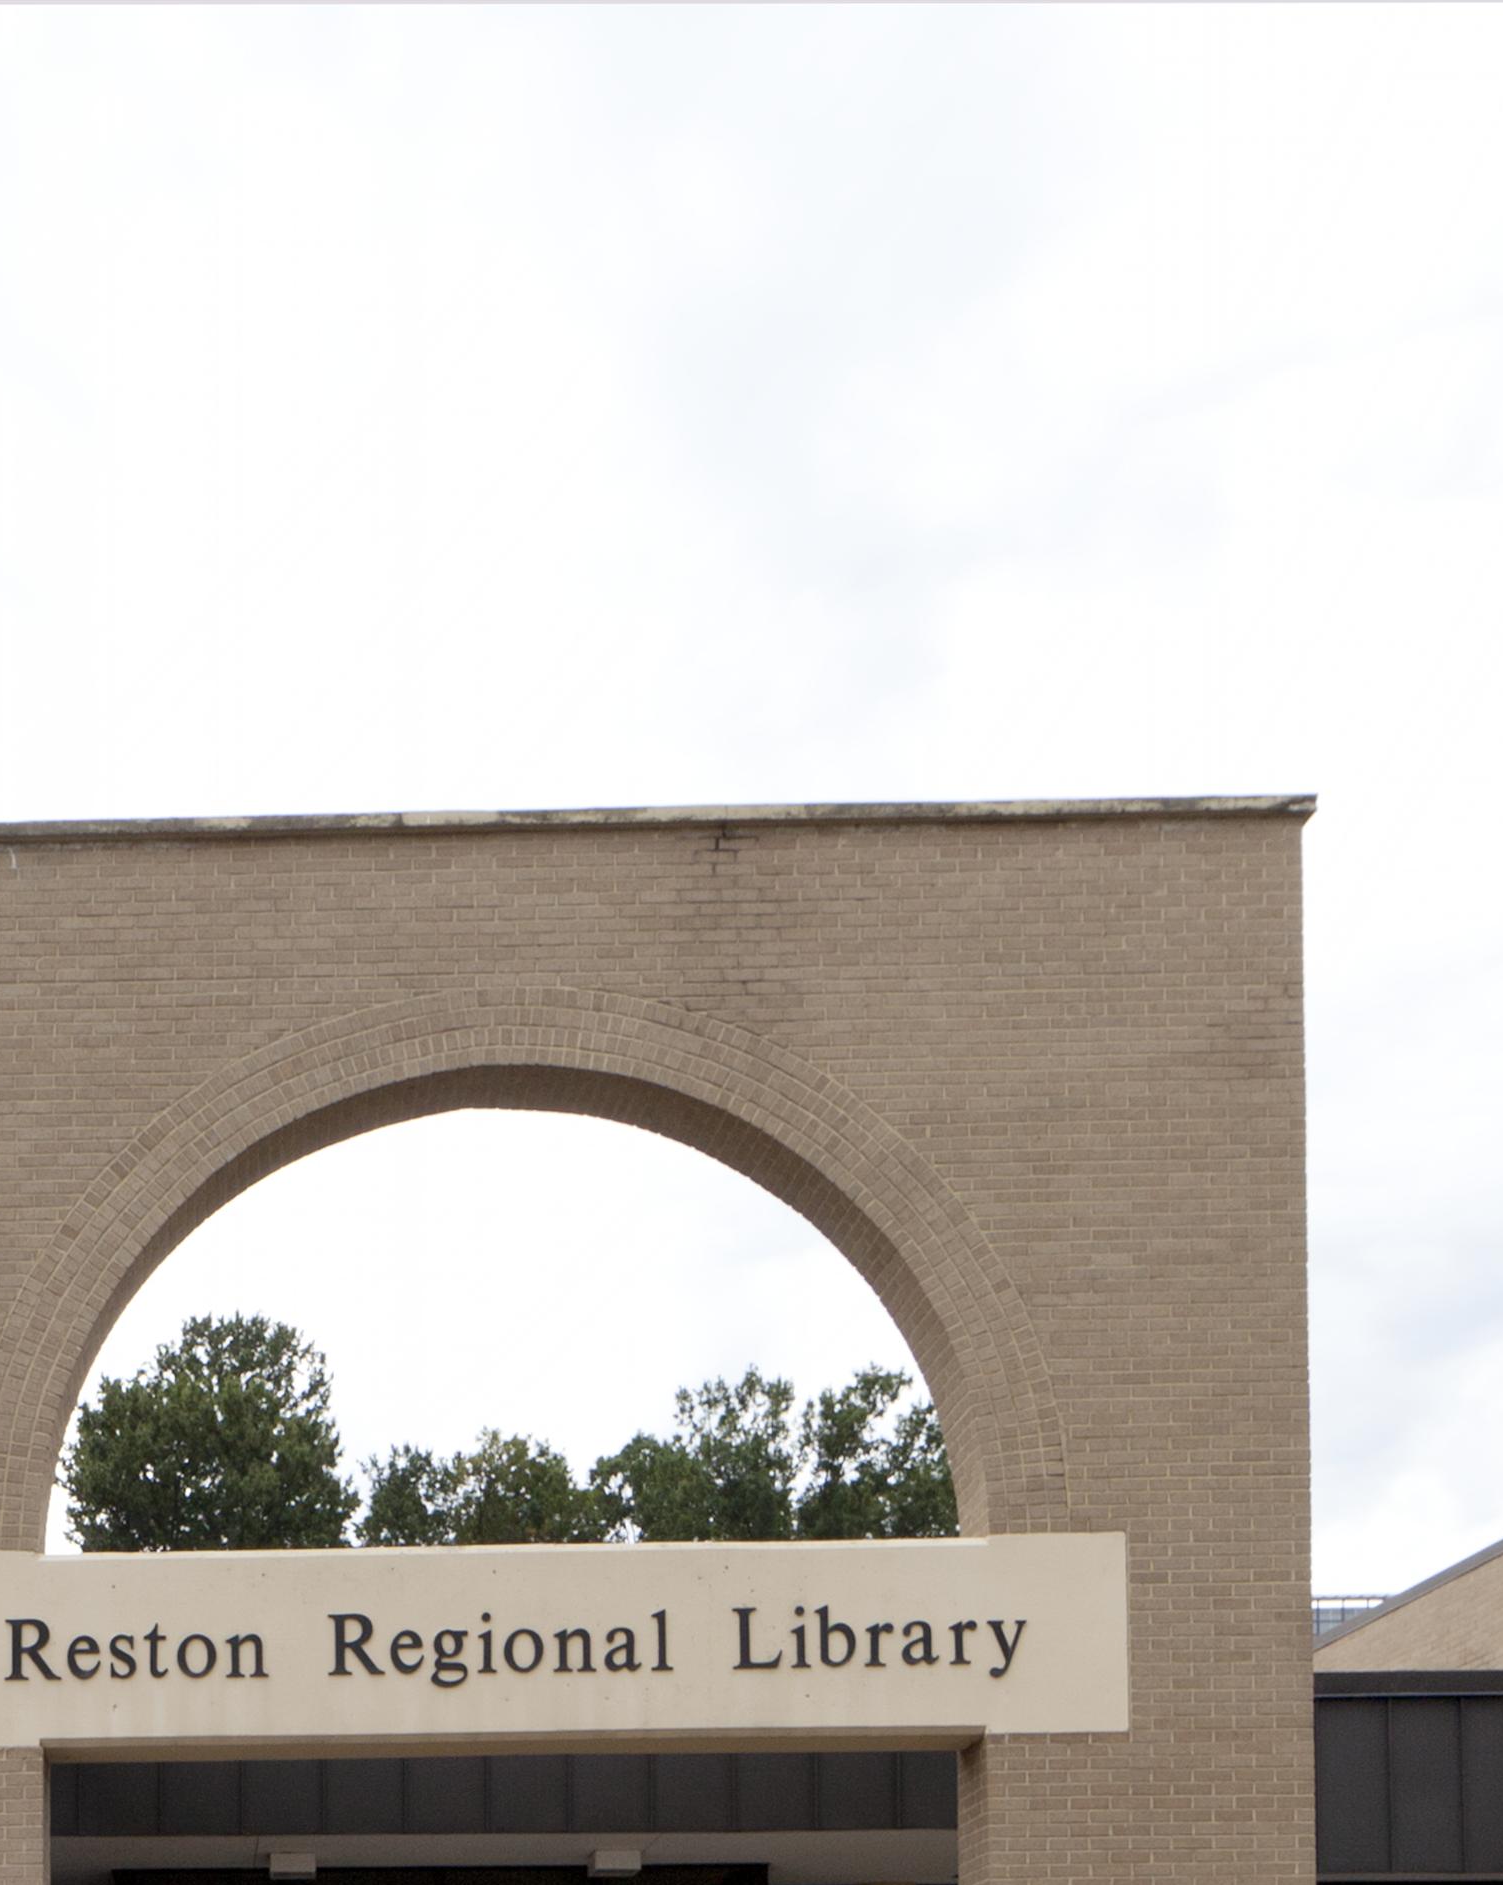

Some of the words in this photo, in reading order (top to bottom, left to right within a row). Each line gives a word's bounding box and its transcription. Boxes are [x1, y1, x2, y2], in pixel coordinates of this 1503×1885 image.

[5, 1619, 269, 1681] Reston
[328, 1609, 673, 1689] Regional
[732, 1605, 1027, 1679] Library
